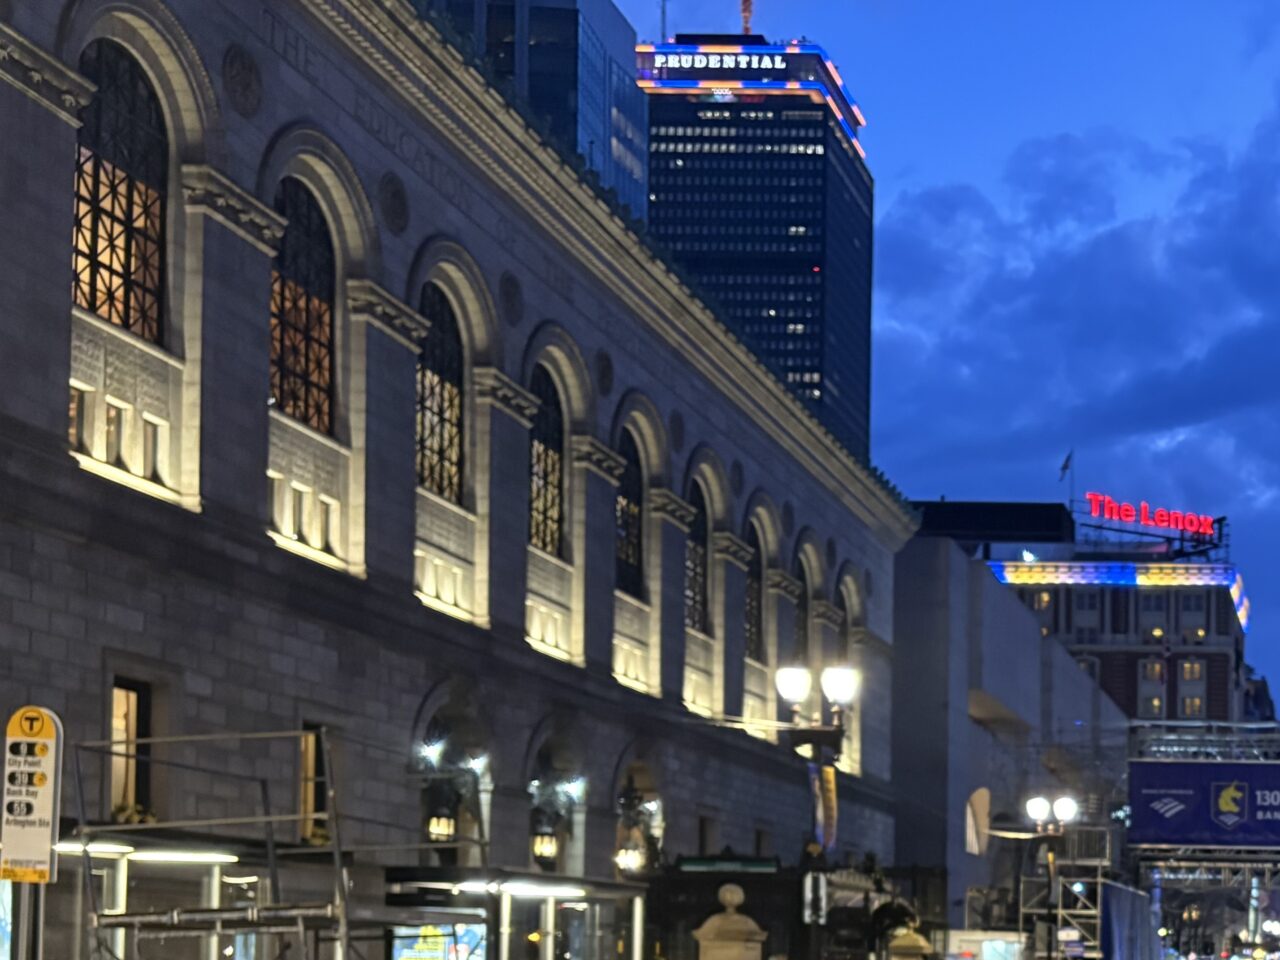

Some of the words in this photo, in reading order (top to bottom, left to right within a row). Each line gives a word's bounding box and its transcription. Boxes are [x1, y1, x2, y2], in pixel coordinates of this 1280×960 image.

[654, 54, 787, 69] PRUDENTIAL
[1086, 491, 1136, 523] The
[1140, 501, 1214, 535] Lenox
[24, 716, 40, 731] T
